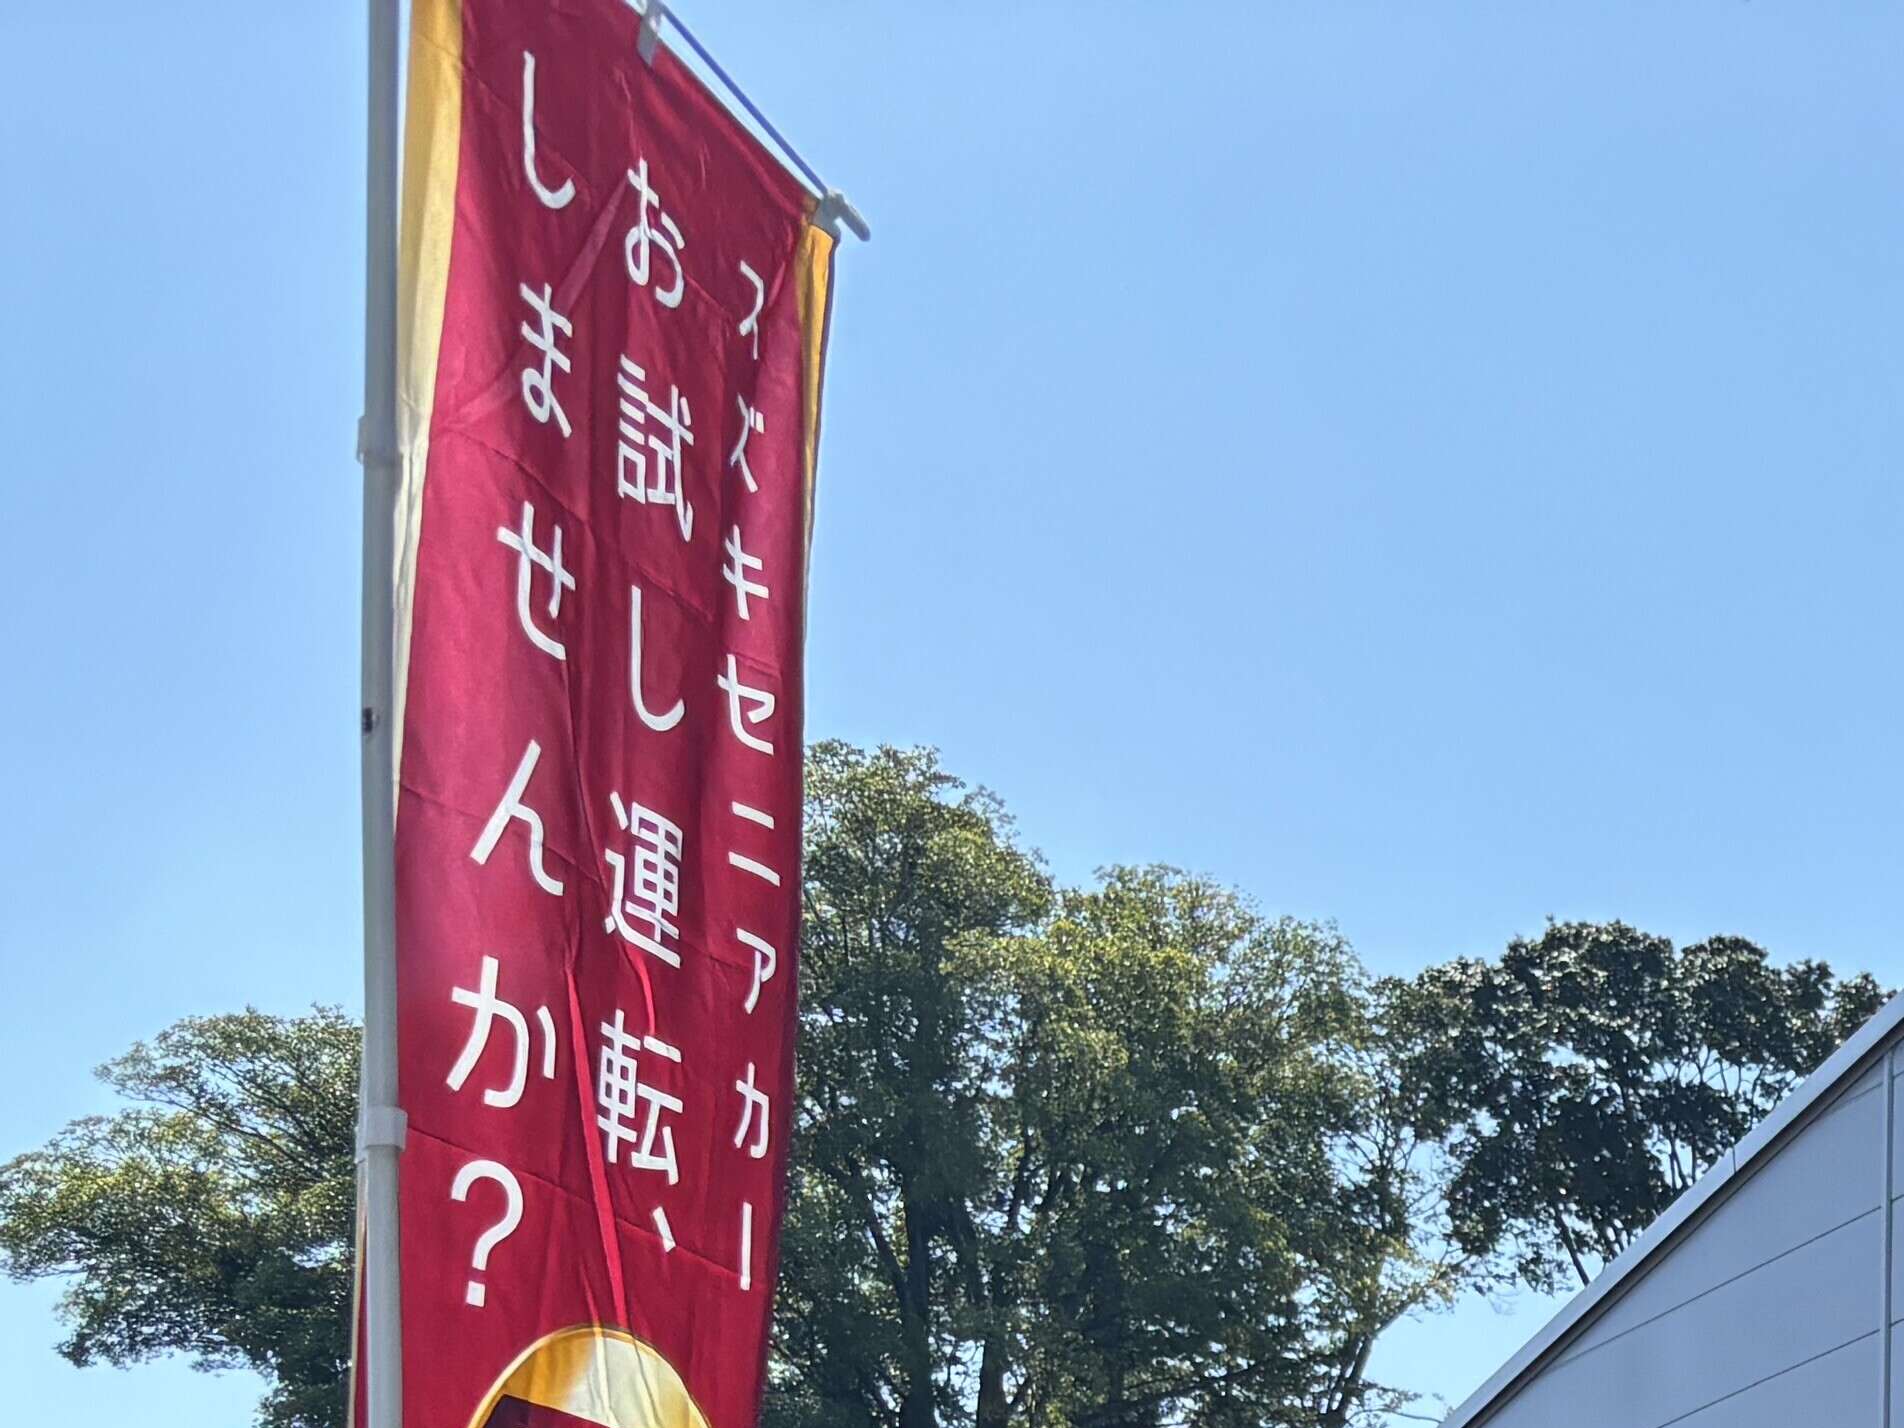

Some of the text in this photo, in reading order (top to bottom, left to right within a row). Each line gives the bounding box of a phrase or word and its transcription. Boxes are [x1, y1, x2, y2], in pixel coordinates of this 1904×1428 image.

[597, 157, 694, 1251] お試し運転、
